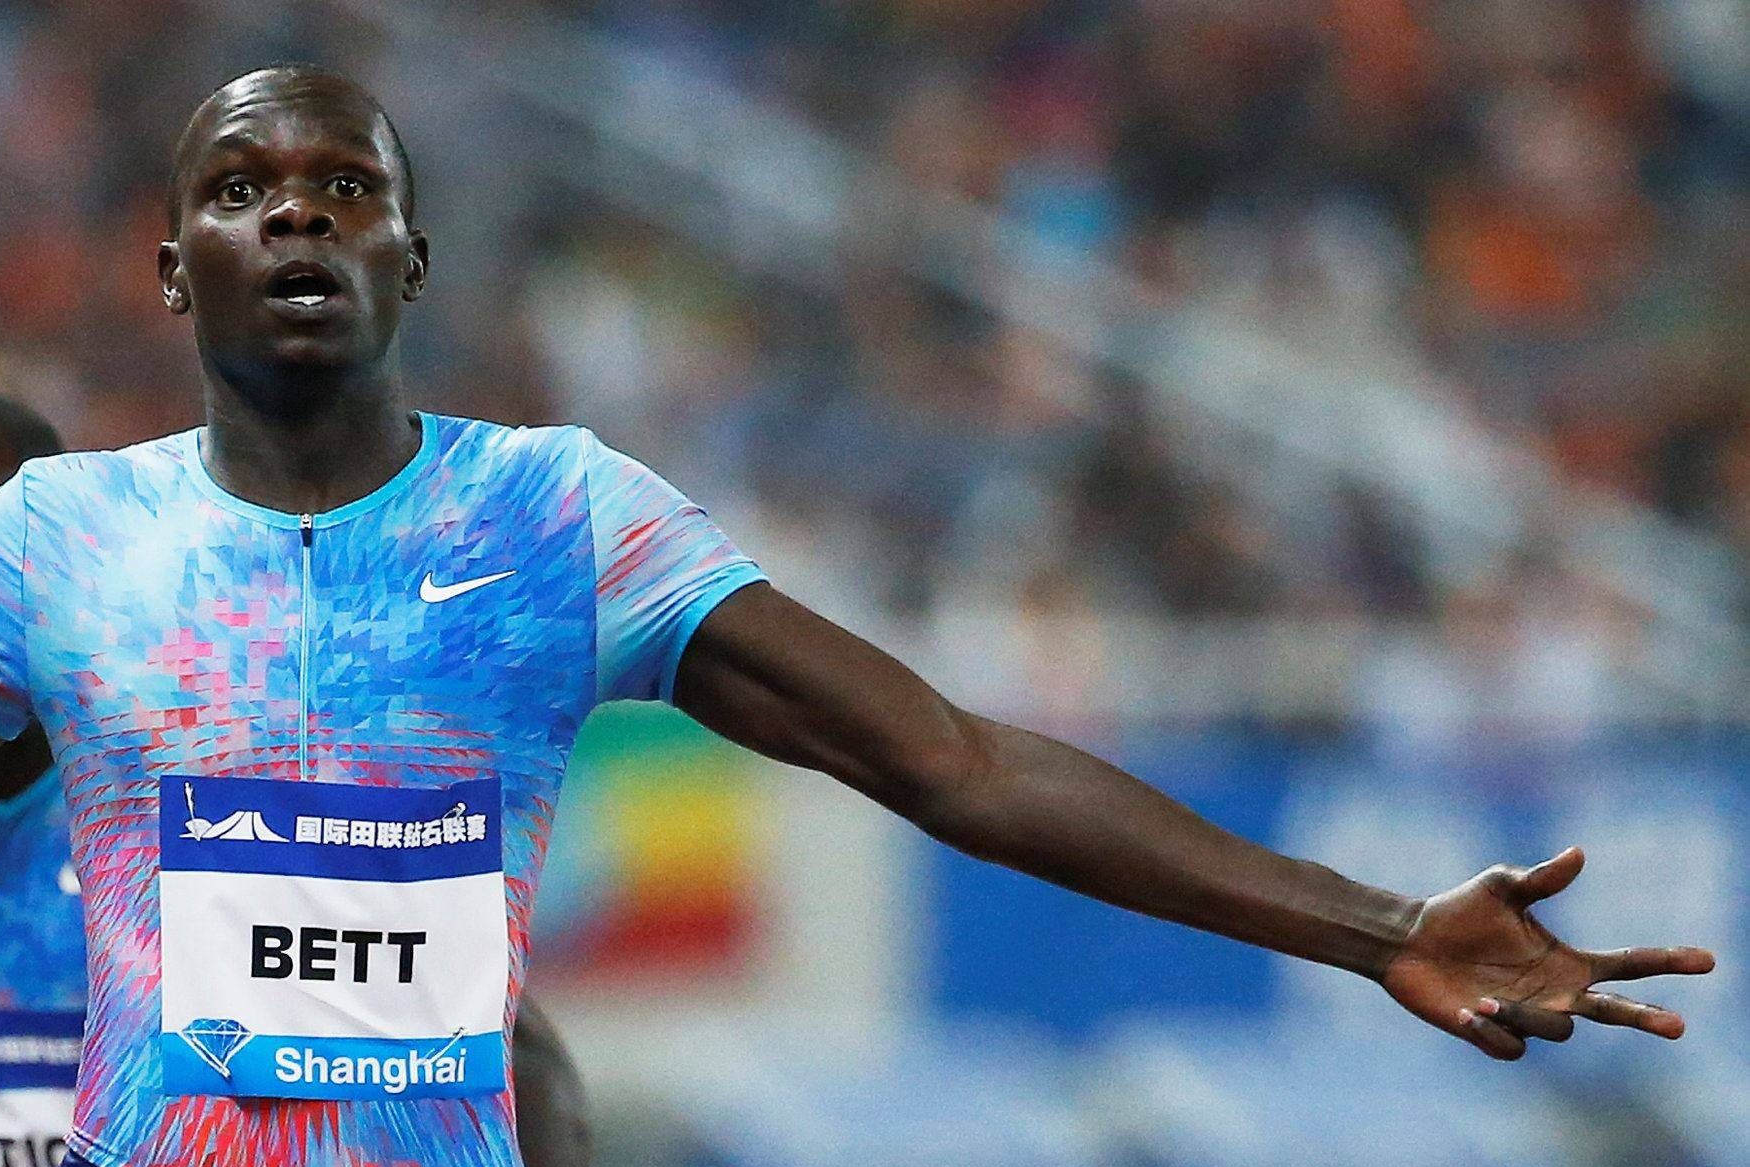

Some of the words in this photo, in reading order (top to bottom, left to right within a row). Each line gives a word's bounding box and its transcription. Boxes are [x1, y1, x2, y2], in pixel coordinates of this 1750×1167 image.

[295, 814, 487, 849] 国际田联钻石联赛
[250, 924, 427, 984] BETT
[274, 1047, 466, 1094] Shanghai
